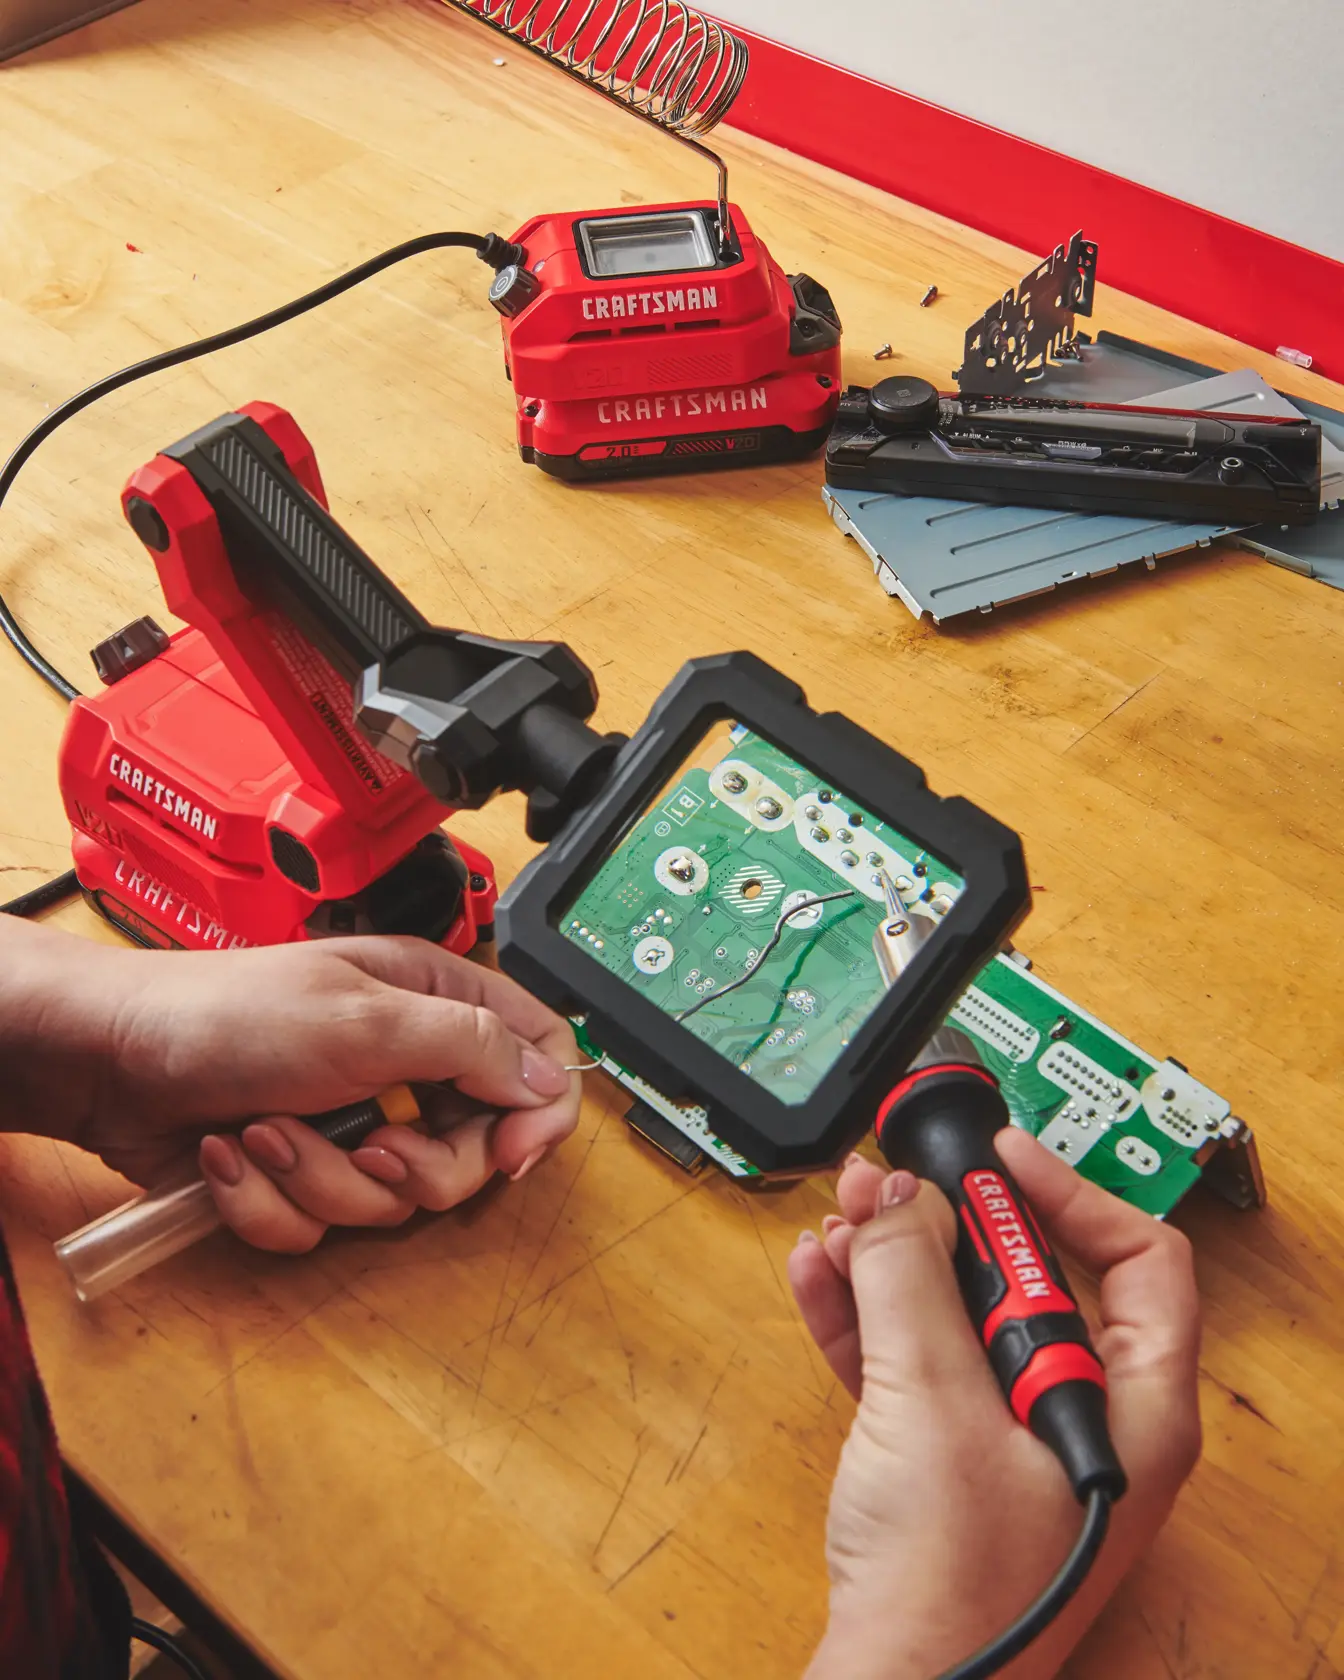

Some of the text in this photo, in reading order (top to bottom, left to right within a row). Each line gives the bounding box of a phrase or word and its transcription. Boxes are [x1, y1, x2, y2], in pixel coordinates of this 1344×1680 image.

[582, 286, 718, 320] CRAFTSMAN
[597, 387, 767, 424] CRAFTSMAN
[725, 436, 755, 450] V20
[110, 753, 217, 840] CRAFTSMAN
[974, 1174, 1051, 1299] CRAFTSMAN
